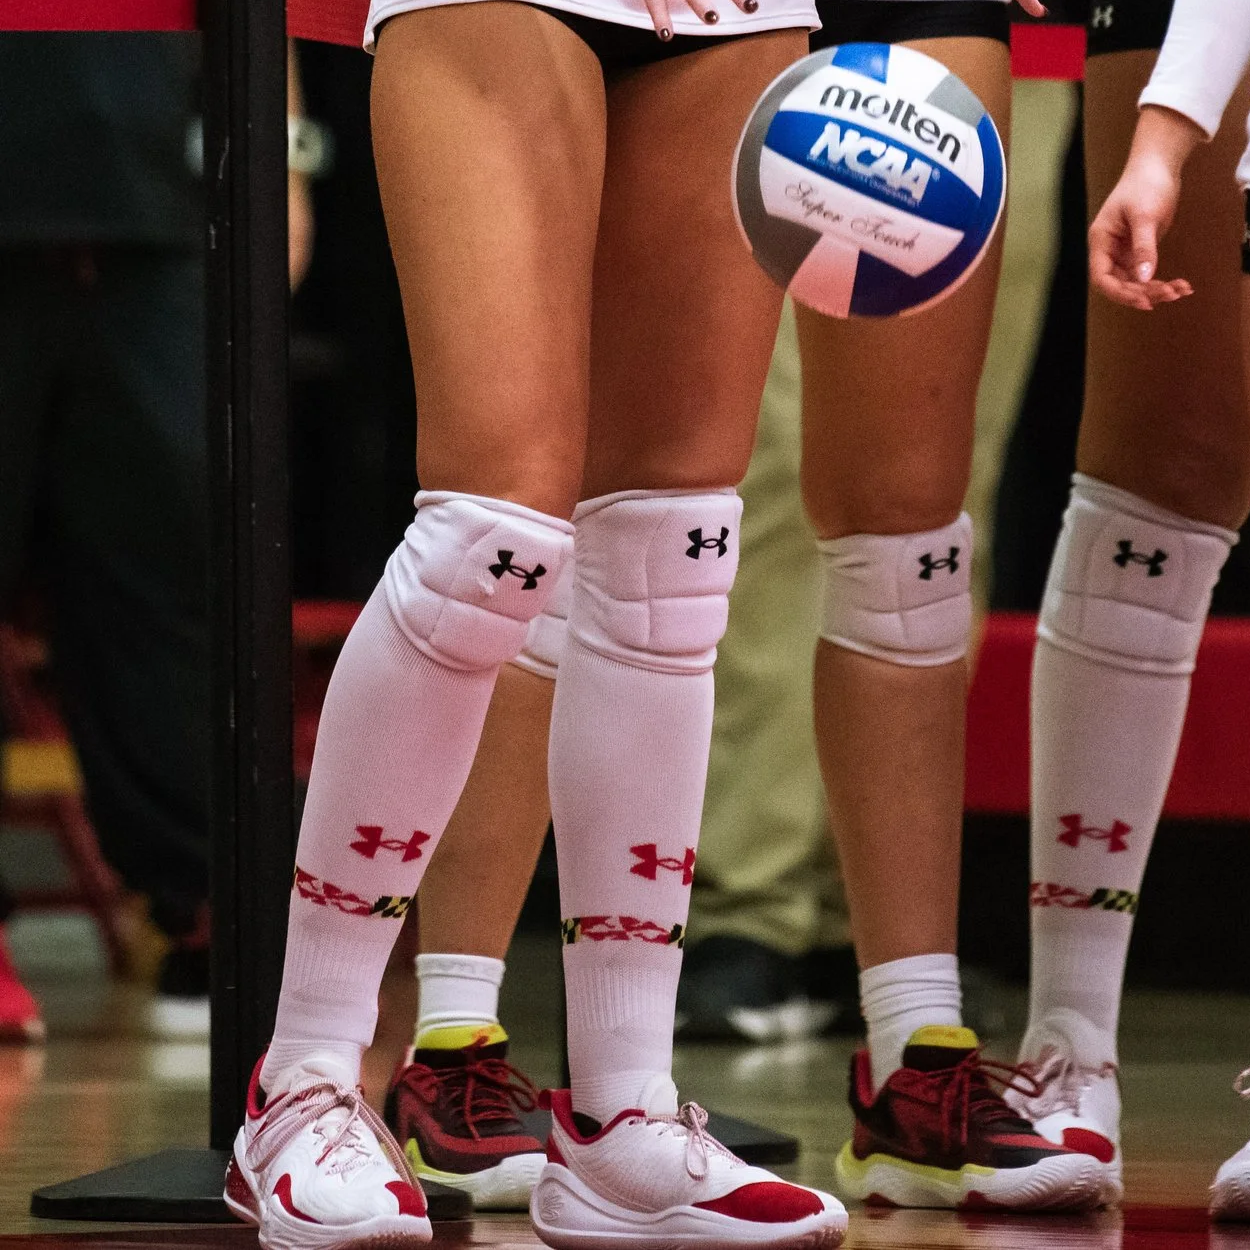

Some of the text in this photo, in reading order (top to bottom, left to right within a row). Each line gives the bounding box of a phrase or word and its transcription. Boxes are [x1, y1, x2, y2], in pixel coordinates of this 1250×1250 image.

[809, 121, 934, 203] NCAA
[819, 84, 962, 164] molten
[785, 181, 844, 223] Super
[850, 214, 922, 251] Touch
